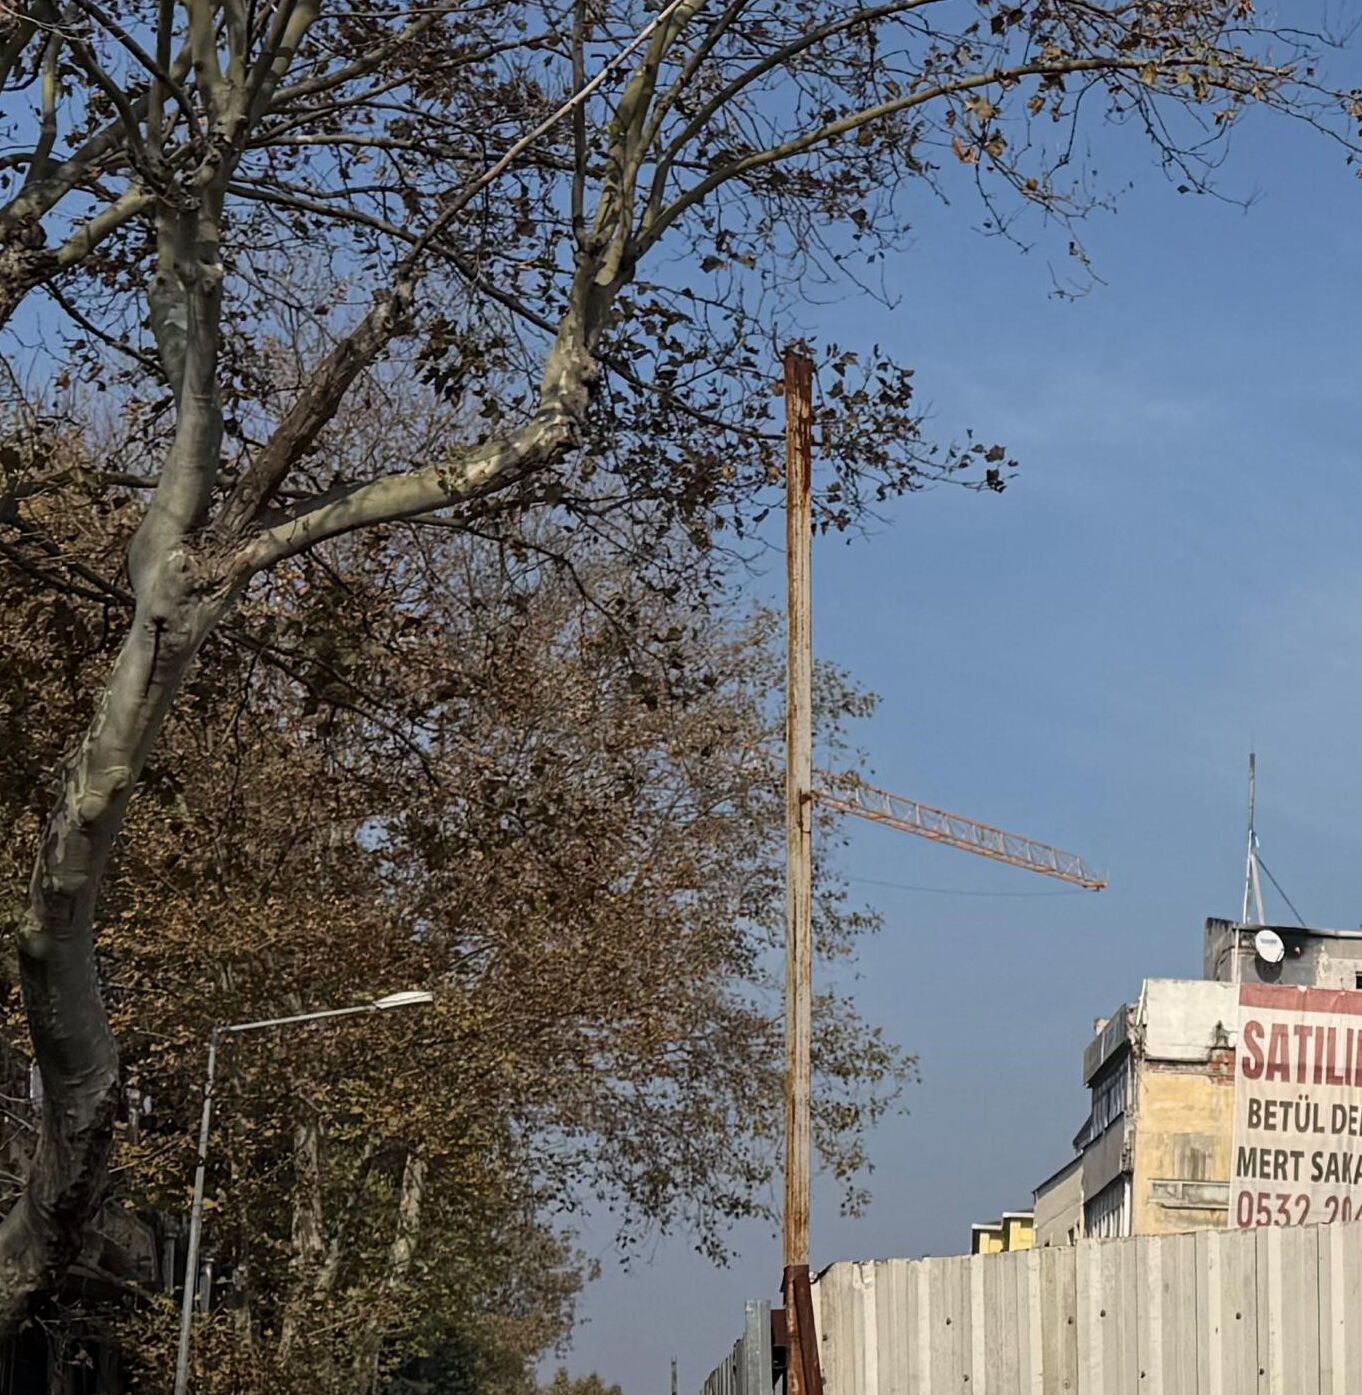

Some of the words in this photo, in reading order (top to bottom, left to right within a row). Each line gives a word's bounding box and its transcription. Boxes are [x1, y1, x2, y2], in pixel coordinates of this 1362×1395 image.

[1247, 1094, 1325, 1134] BETÜL
[1236, 1146, 1304, 1182] MERT
[1236, 1190, 1311, 1228] 0532
